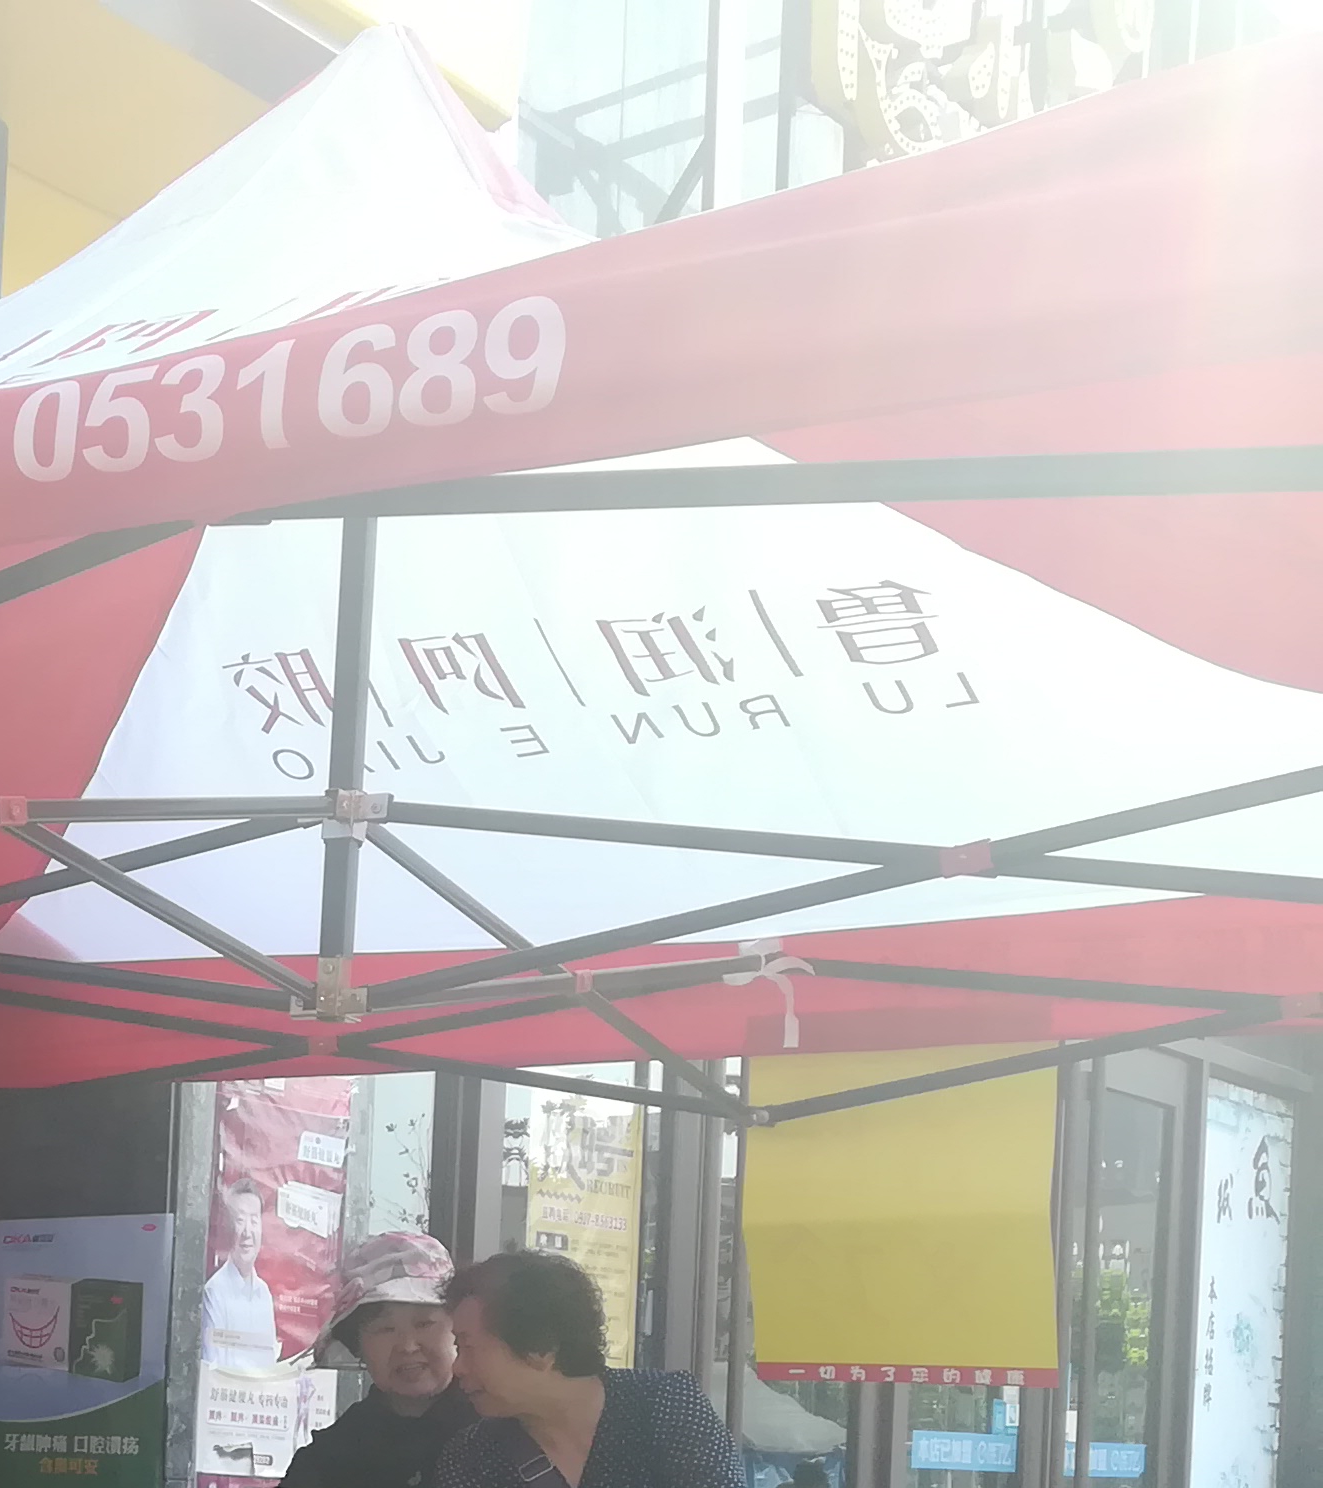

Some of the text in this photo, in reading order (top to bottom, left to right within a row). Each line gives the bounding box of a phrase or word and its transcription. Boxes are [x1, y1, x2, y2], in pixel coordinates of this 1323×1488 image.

[788, 1365, 1026, 1386] 一切为了您的健康
